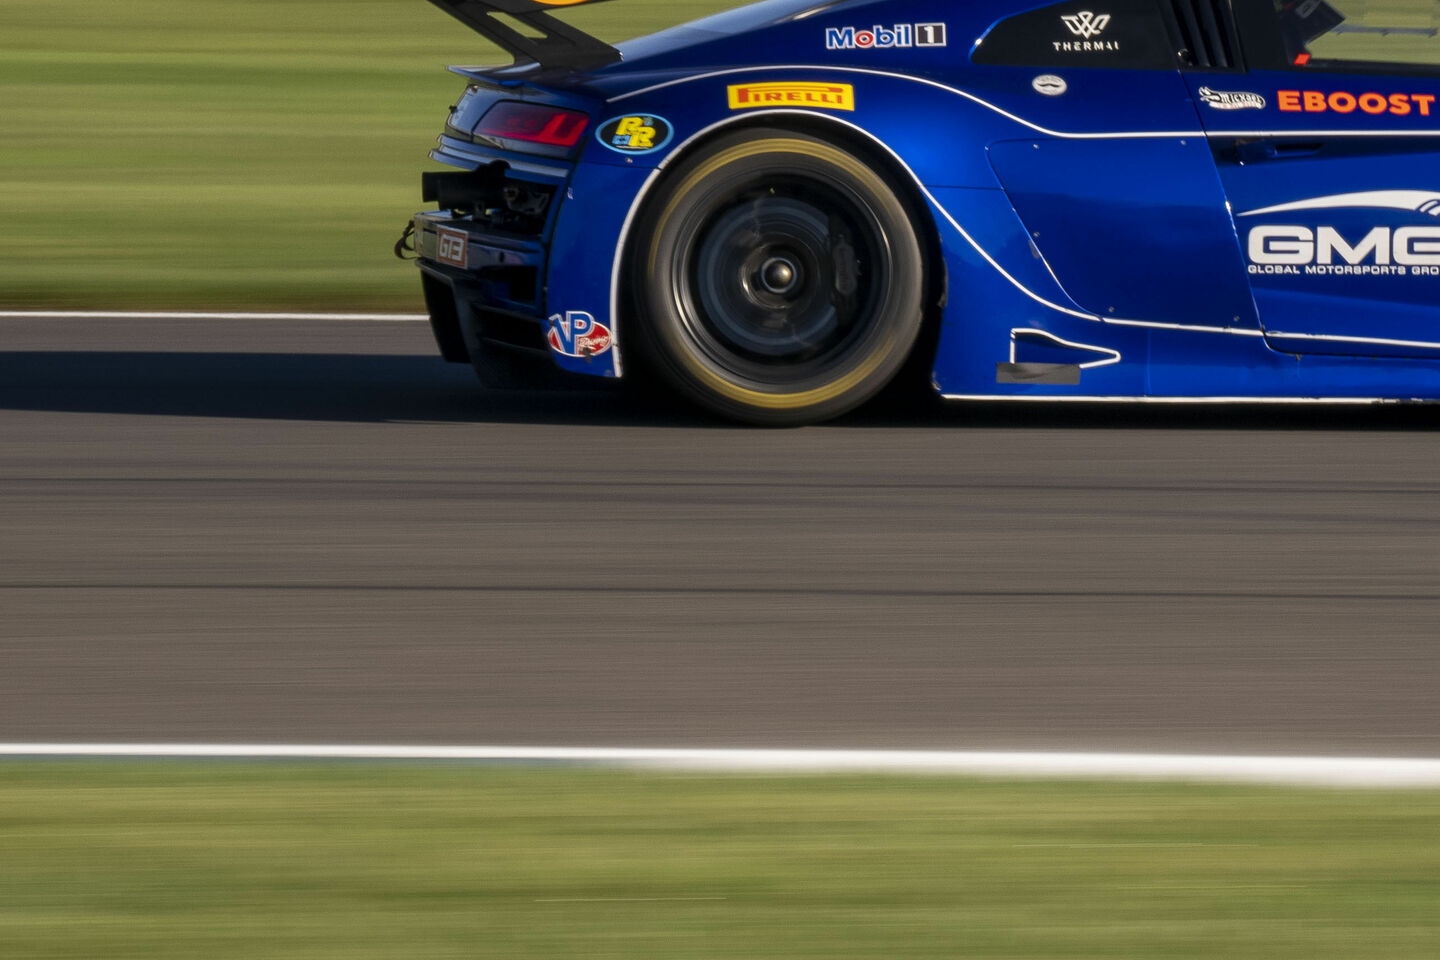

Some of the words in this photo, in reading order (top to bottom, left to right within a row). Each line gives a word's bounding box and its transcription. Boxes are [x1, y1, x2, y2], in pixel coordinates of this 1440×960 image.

[825, 24, 912, 49] Mobil
[737, 87, 844, 105] PIRELLI
[1277, 90, 1436, 116] EBOOST
[440, 234, 464, 261] GT3
[1247, 264, 1301, 275] GLOBAL
[1305, 265, 1406, 275] MOTORSPORTS
[549, 311, 595, 355] VP
